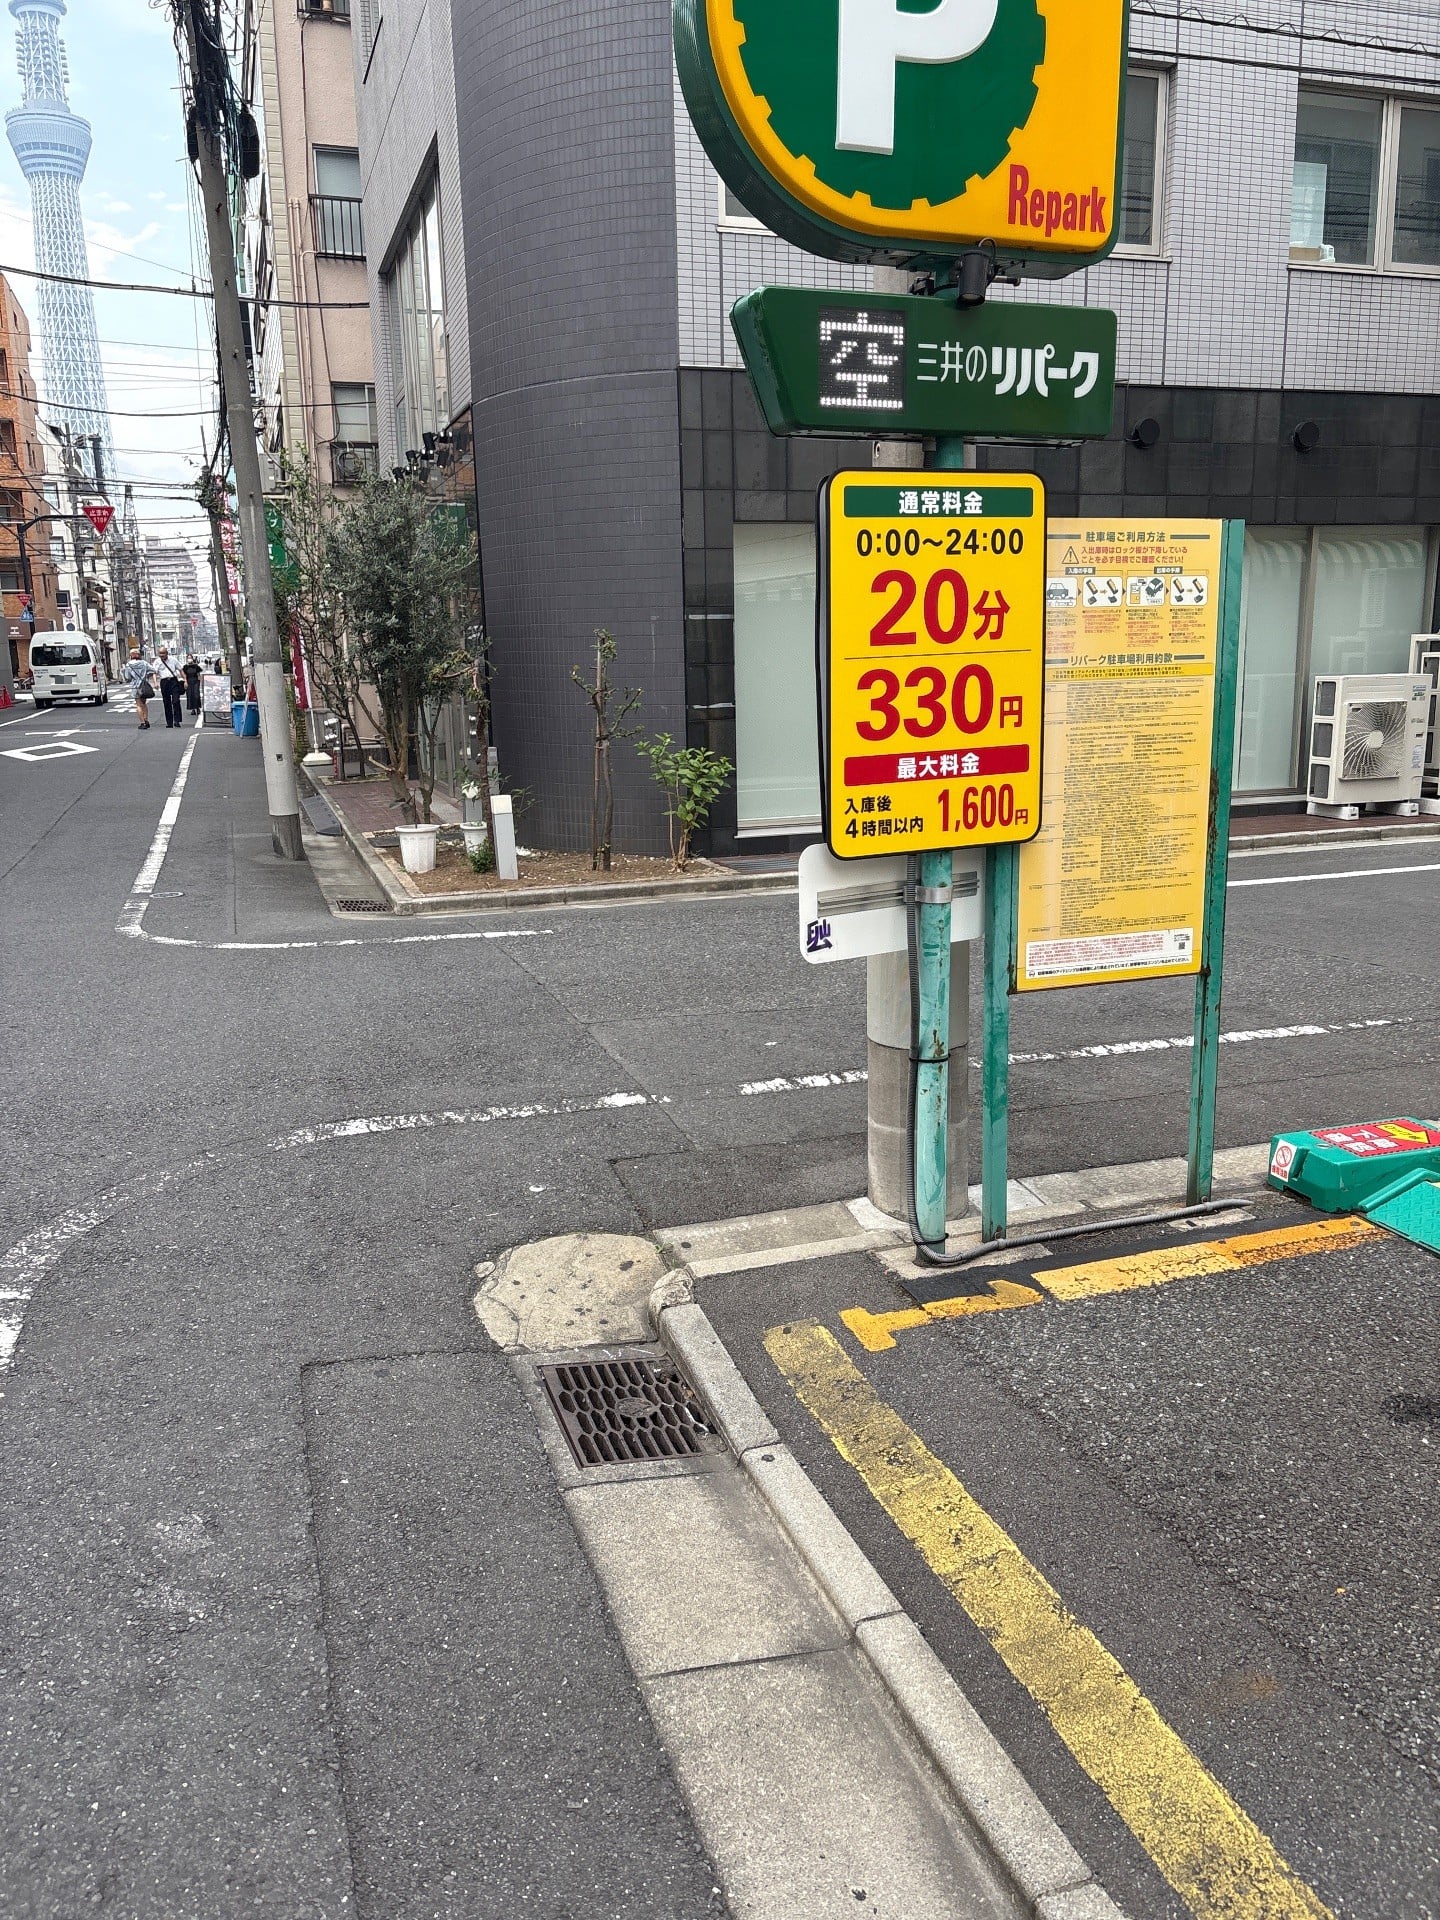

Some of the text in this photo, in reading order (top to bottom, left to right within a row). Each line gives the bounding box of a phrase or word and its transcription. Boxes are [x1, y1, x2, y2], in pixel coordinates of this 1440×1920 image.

[834, 0, 998, 155] P
[1008, 164, 1107, 237] Repark
[819, 312, 905, 409] 空
[916, 341, 1099, 399] 三井のリパーク
[898, 490, 983, 515] 通常料金
[1086, 531, 1166, 543] 駐車場ご利用方法
[869, 568, 1011, 647] 20分
[855, 663, 1024, 742] 330円
[897, 752, 980, 780] 最大料金
[844, 796, 892, 815] 入庫後
[845, 815, 924, 839] 4時間以内
[937, 783, 1029, 832] 1,600円
